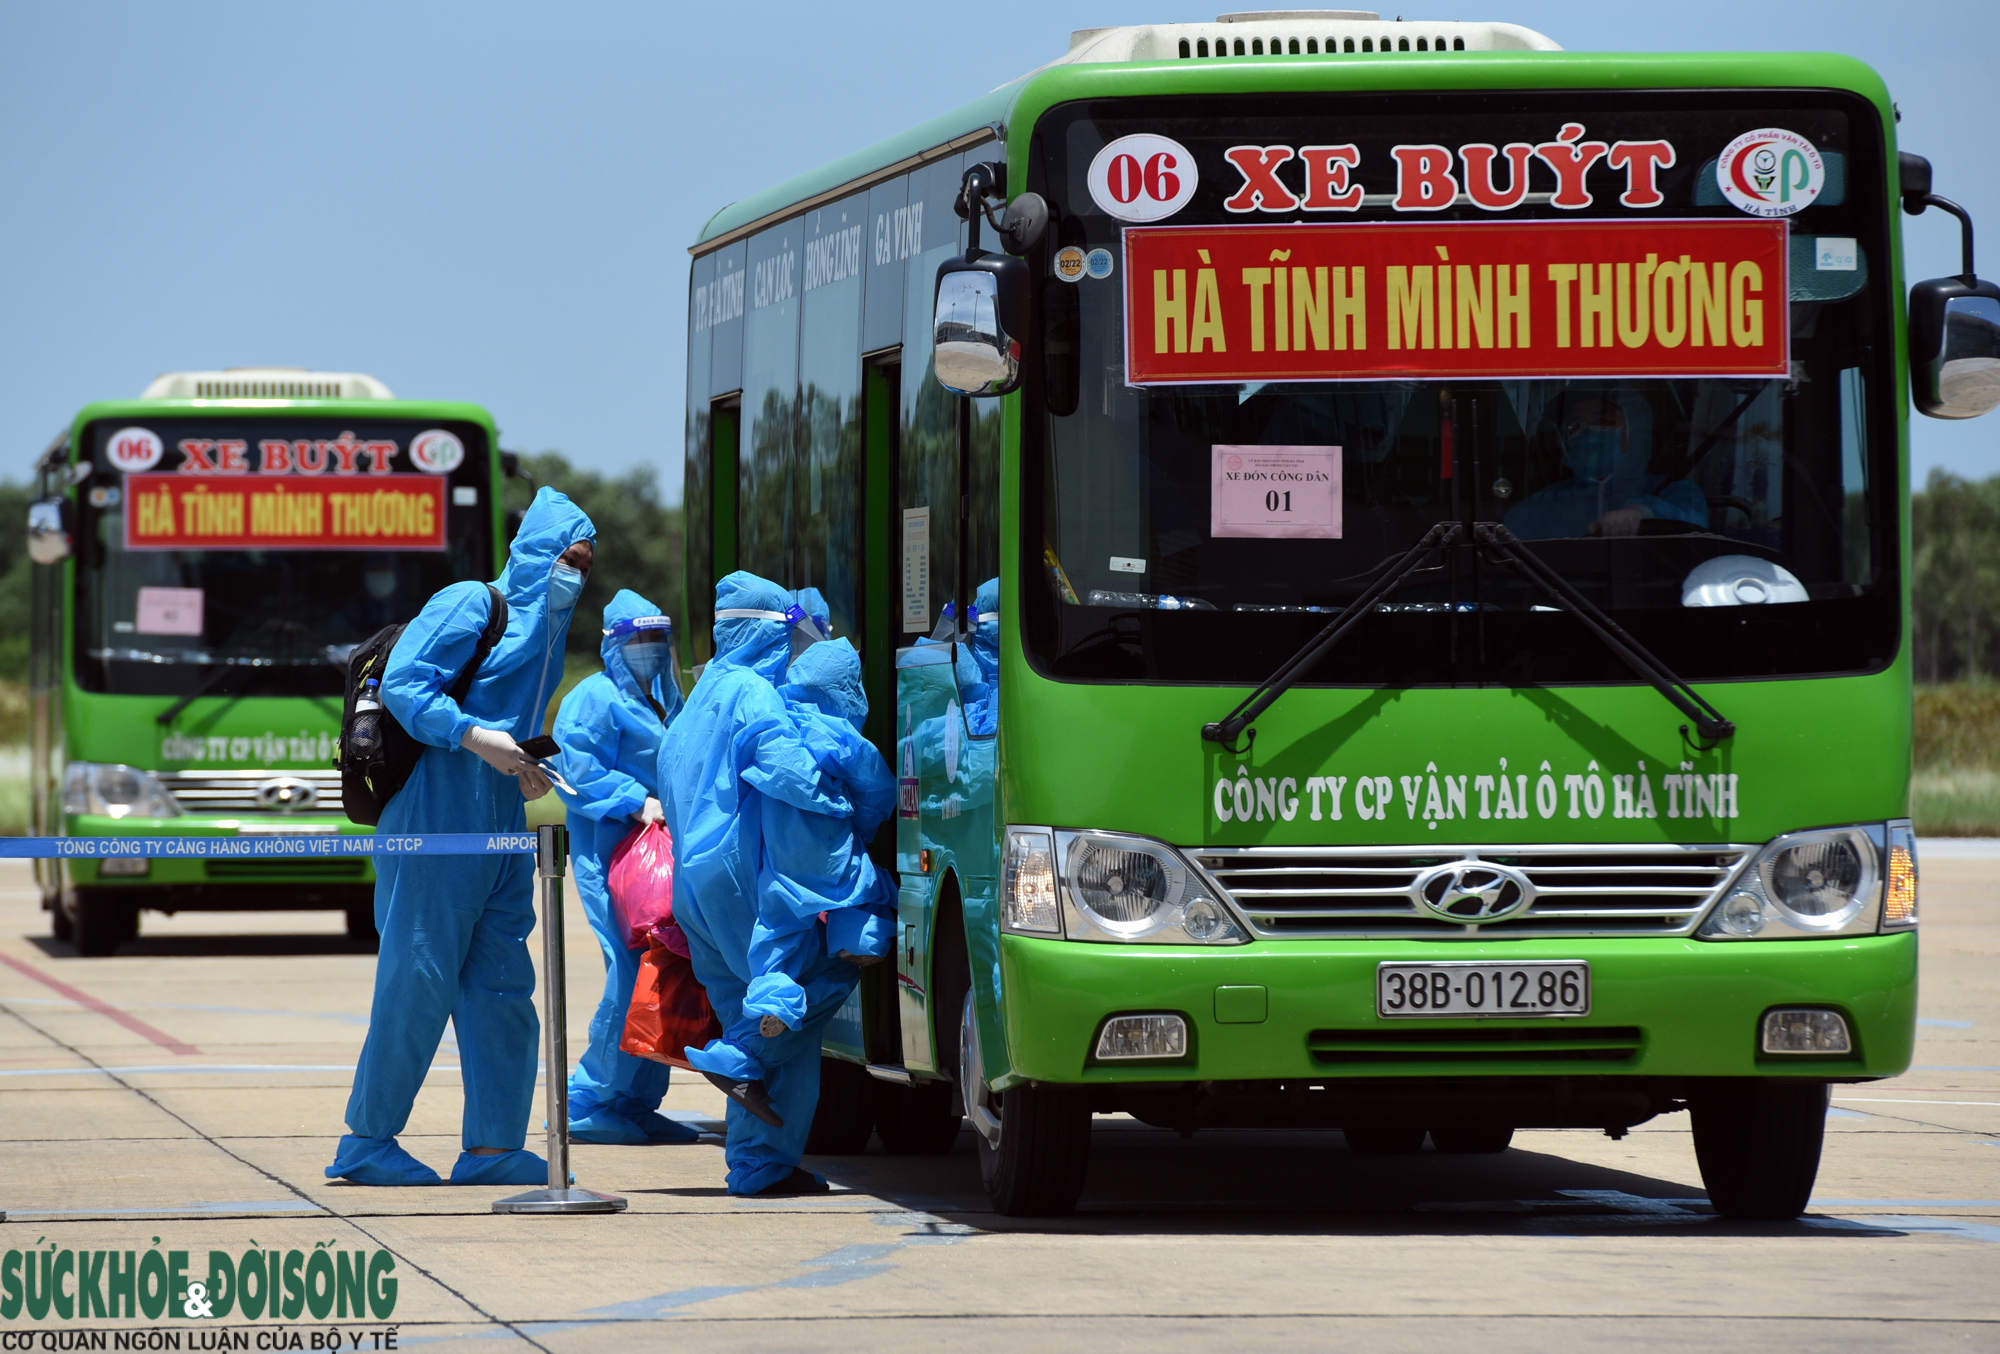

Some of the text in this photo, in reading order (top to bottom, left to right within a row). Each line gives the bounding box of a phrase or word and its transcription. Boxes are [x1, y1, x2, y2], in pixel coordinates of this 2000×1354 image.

[1106, 152, 1181, 204] 06
[1224, 122, 1677, 213] XE BUÝT
[875, 201, 924, 267] GA VINH
[754, 257, 776, 310] CAN
[1060, 259, 1081, 268] 02/22
[1153, 246, 1764, 354] HÀ TĨNH MÌNH THƯƠNG
[118, 438, 153, 461] 06
[178, 438, 250, 475] XE
[1225, 470, 1329, 482] XE ĐÓN CÔNG DÂN
[138, 483, 176, 536] HÀ
[1265, 489, 1293, 512] 01
[1214, 757, 1739, 830] CÔNG TY CP VẬN TẢI Ô TÔ HÀ TĨNH
[56, 837, 96, 855] TỔNG
[100, 838, 141, 855] CÔNG
[144, 841, 163, 854] TY
[166, 837, 207, 855] CẢNG
[210, 838, 251, 855] HÀNG
[254, 837, 306, 854] KHÔNG
[309, 838, 340, 856] VIỆT
[343, 838, 374, 852] NAM
[386, 838, 423, 852] CTCP
[486, 836, 538, 850] AIRPOR
[1386, 970, 1580, 1010] 38B-012.86
